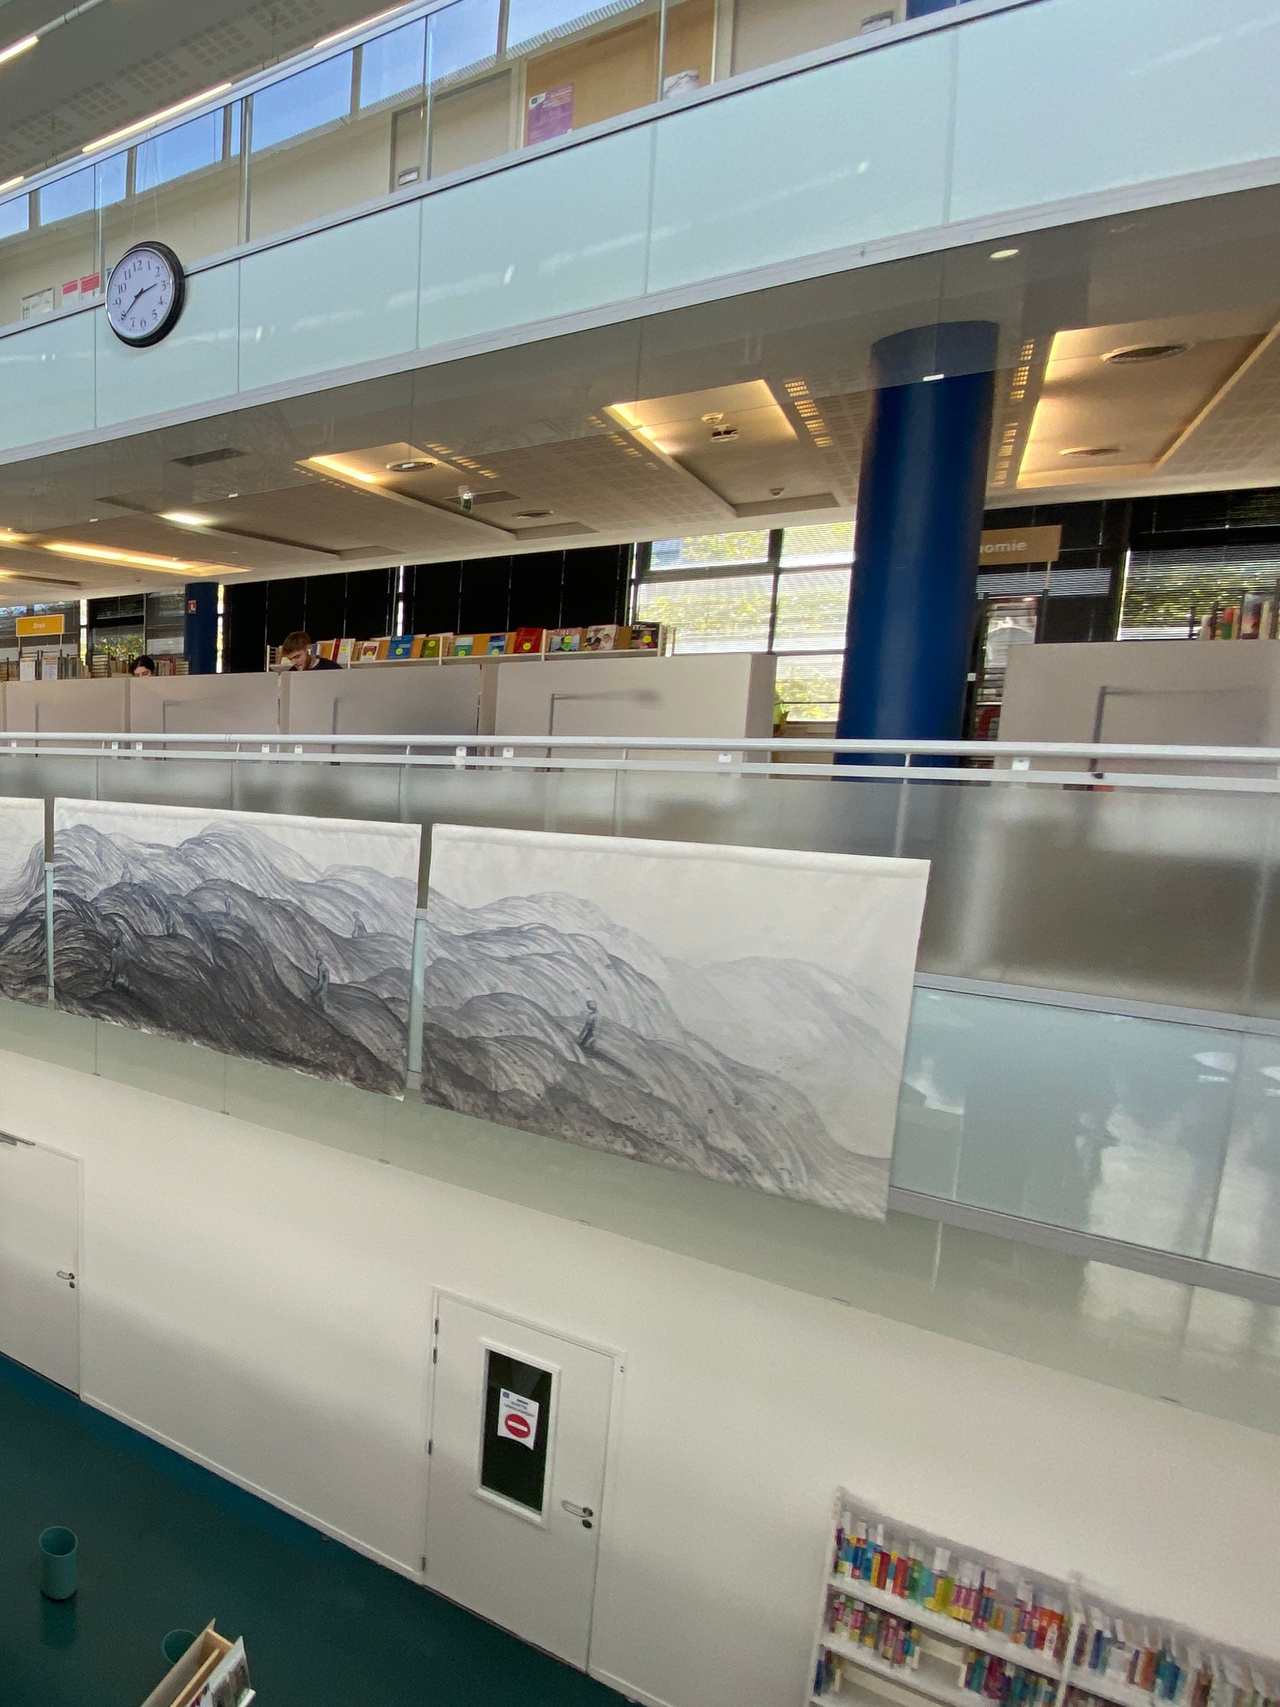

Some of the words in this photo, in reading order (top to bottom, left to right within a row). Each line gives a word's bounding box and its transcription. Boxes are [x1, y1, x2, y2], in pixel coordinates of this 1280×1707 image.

[133, 260, 143, 272] 12
[147, 261, 151, 271] 1
[155, 266, 161, 277] 2
[124, 269, 132, 280] 11
[118, 283, 127, 294] 10
[161, 280, 167, 291] 3
[115, 298, 122, 308] 9
[158, 296, 164, 306] 4
[152, 309, 158, 320] 5
[130, 317, 136, 327] 7
[140, 317, 147, 328] 6
